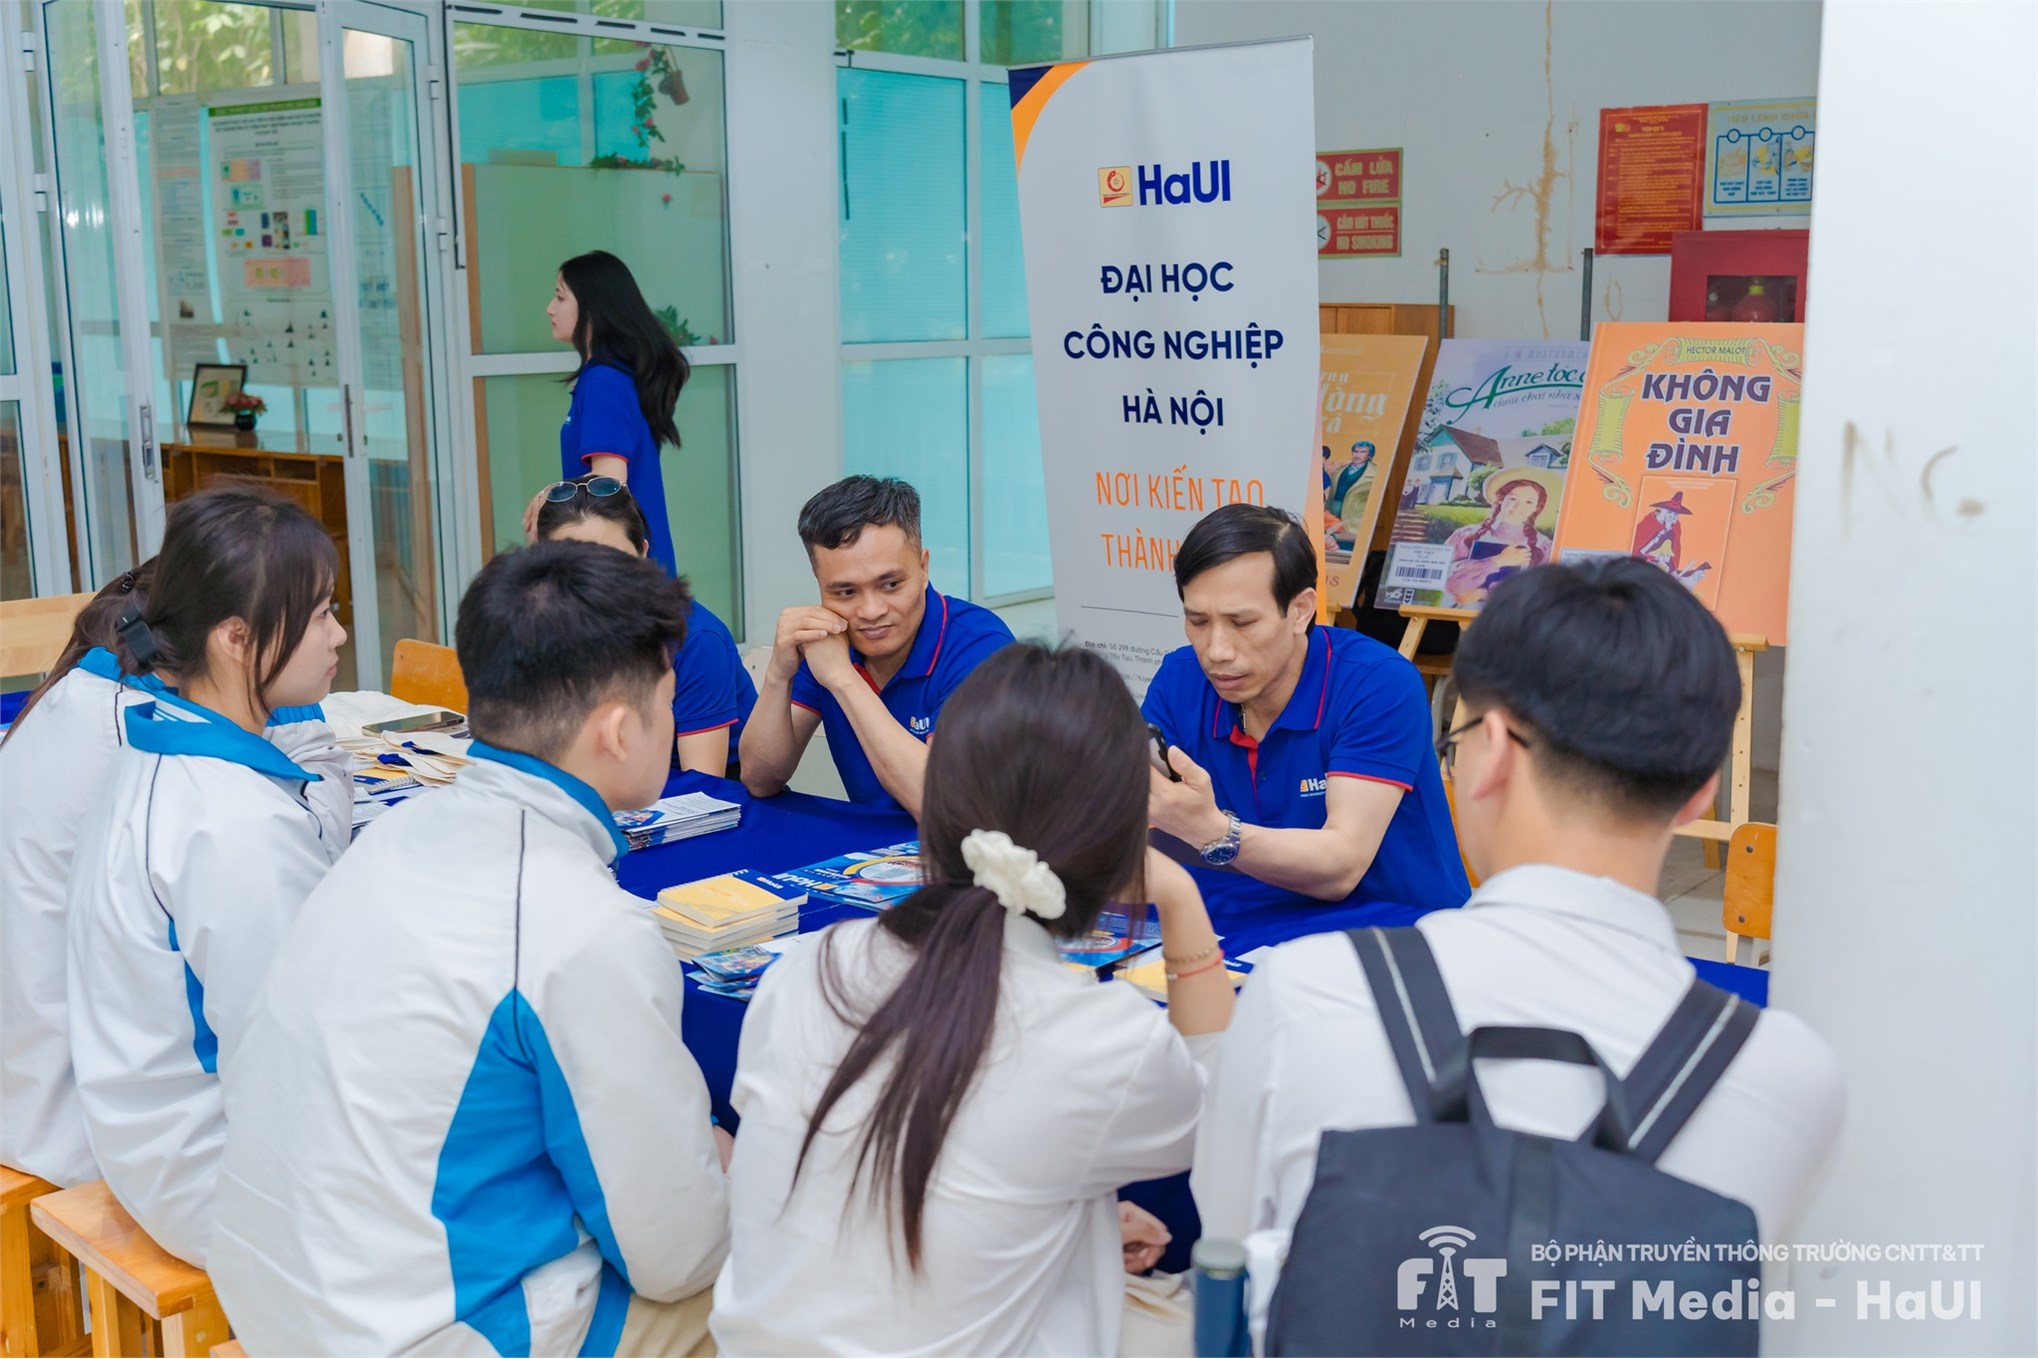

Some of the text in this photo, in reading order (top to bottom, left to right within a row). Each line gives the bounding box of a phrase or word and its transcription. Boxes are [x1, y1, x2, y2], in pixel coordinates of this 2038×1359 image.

[1138, 160, 1231, 206] HaUI
[1338, 178, 1389, 195] NO FIRE
[1351, 234, 1393, 250] SMOKING
[1101, 261, 1235, 302] ĐẠI HỌC
[1063, 322, 1284, 369] CÔNG NGHIỆP
[1687, 346, 1746, 355] HECTOR MALOT
[1445, 362, 1578, 425] Anne tóc
[1641, 368, 1771, 403] KHÔNG
[1122, 388, 1224, 435] HÀ NỘI
[1668, 408, 1732, 438] GIA
[1646, 437, 1740, 475] ĐÌNH
[1096, 471, 1140, 507] NƠI
[1147, 464, 1204, 512] KIẾN
[1101, 528, 1181, 572] THÀNH
